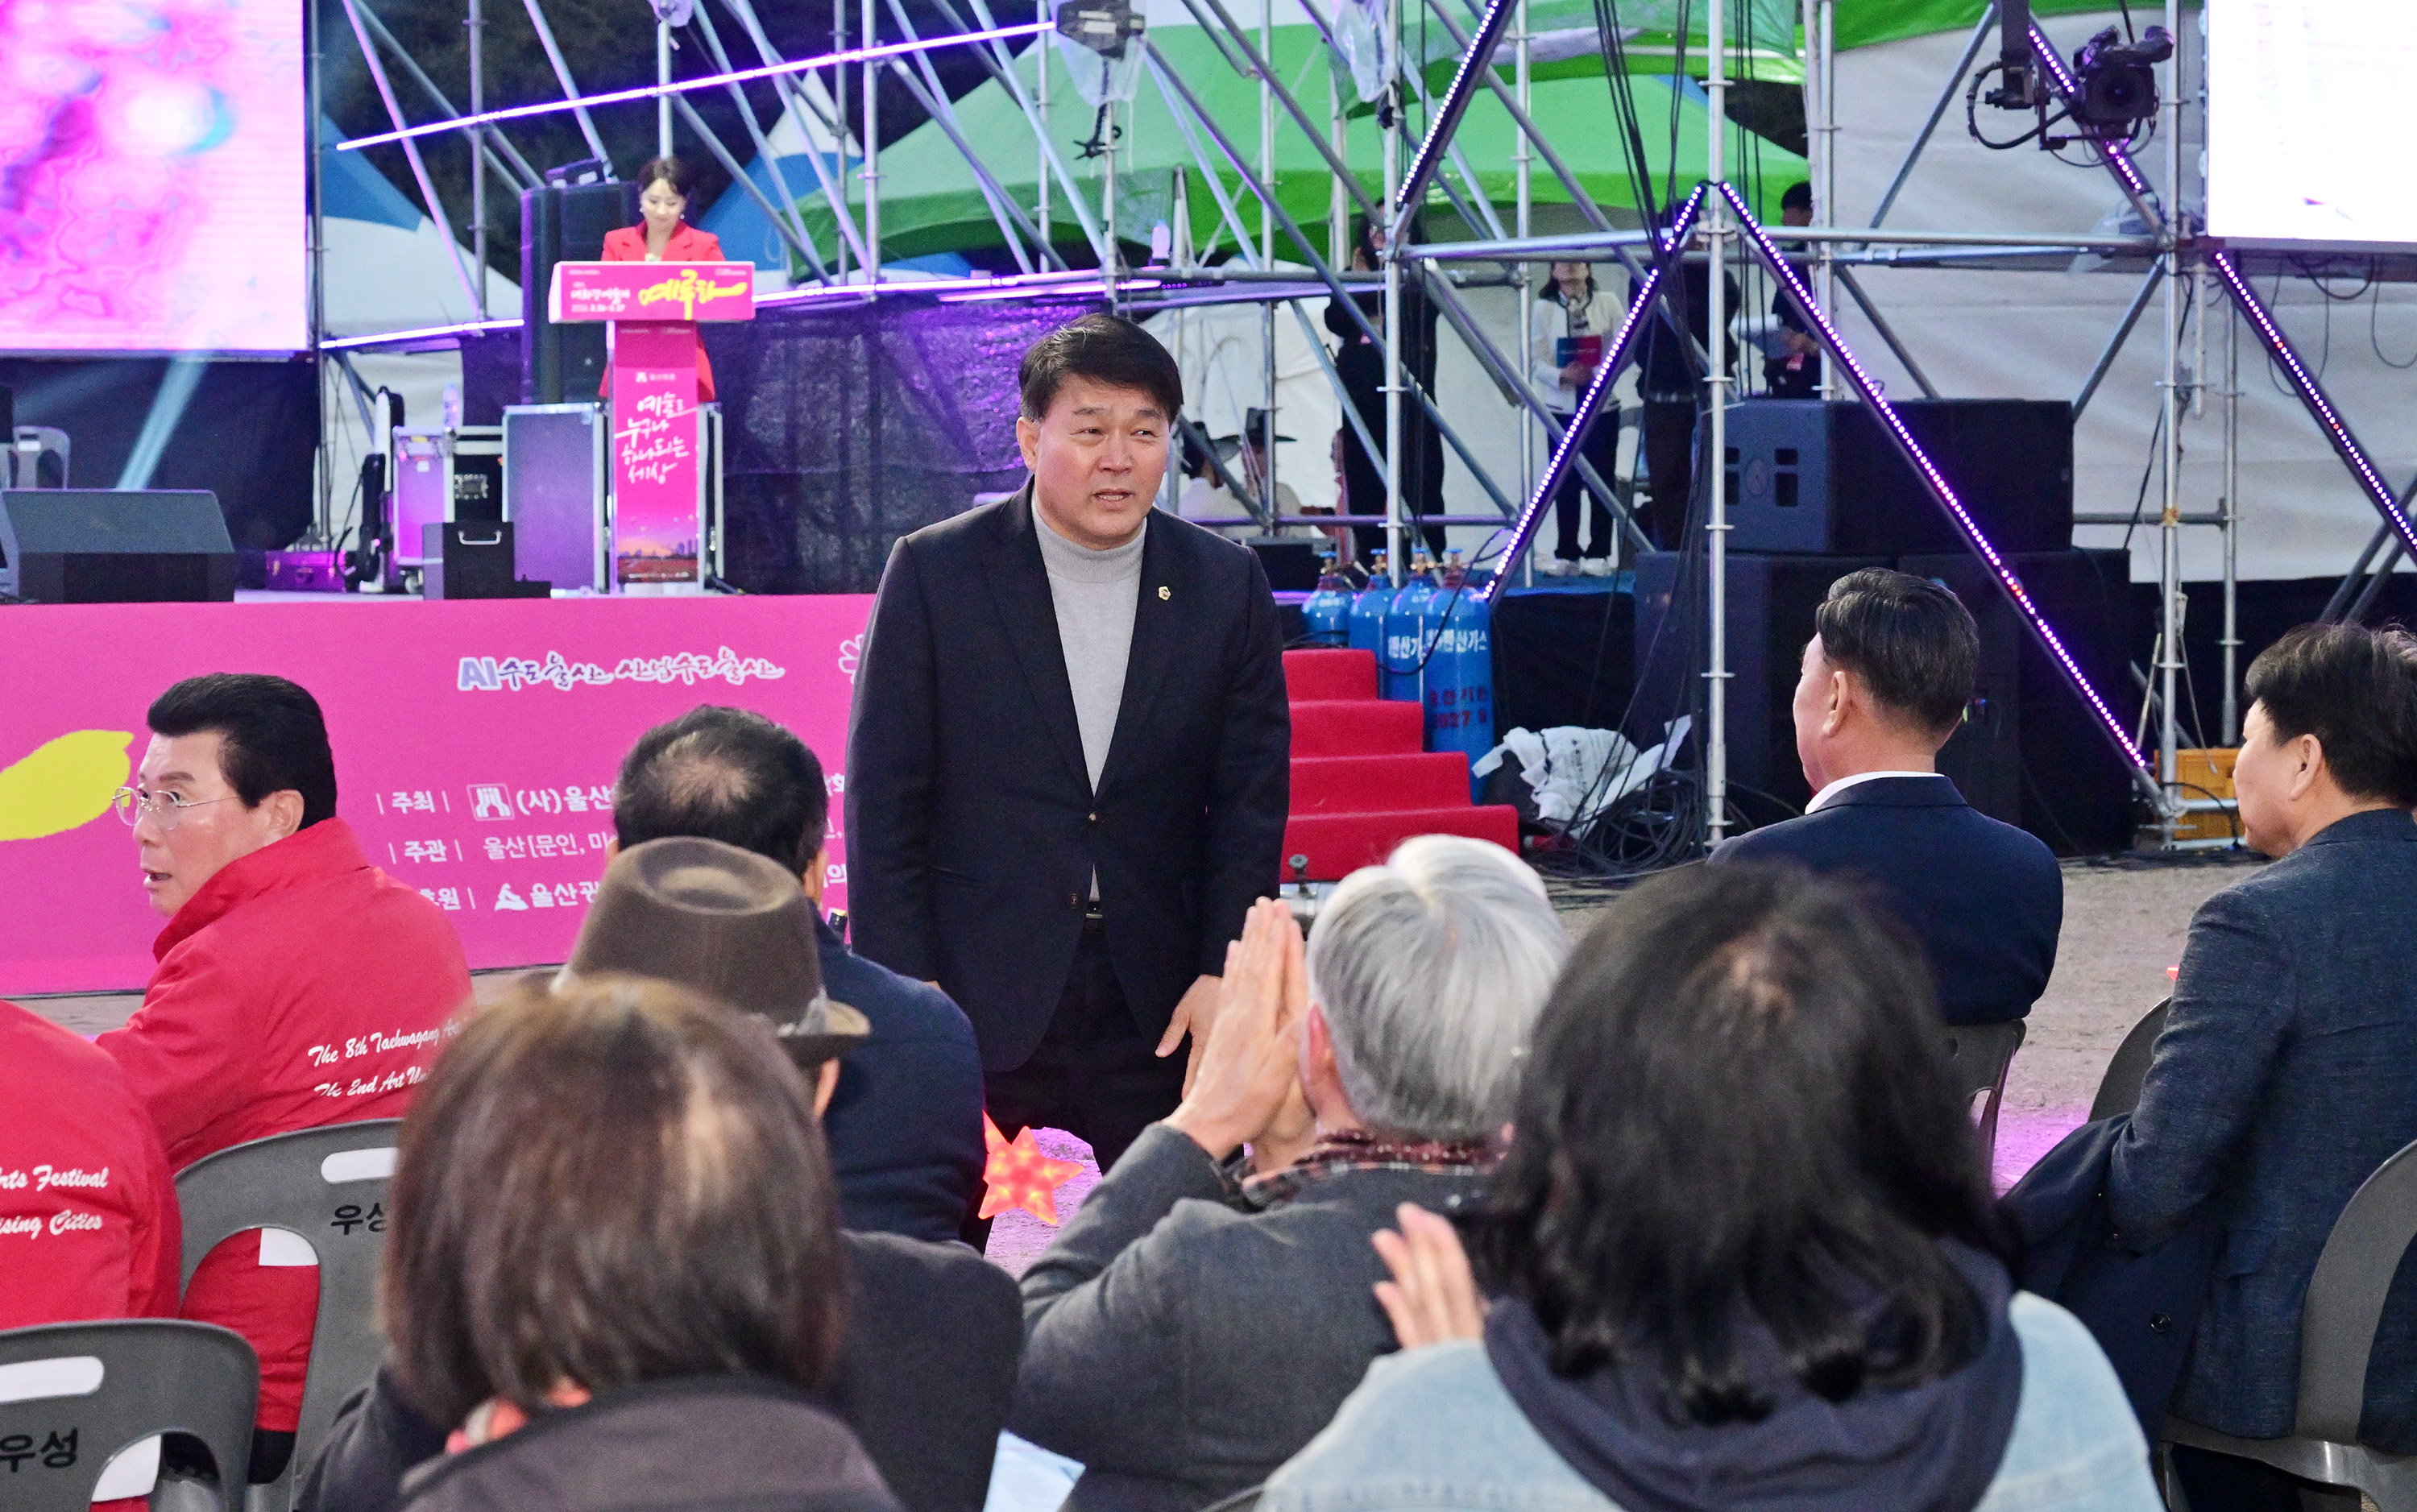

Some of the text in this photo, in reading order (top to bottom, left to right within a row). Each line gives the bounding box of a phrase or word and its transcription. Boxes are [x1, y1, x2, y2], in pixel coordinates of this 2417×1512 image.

[614, 417, 670, 449] 누구나
[628, 461, 678, 484] 세상
[392, 790, 435, 814] 주최
[404, 839, 447, 863] 주관
[308, 1044, 338, 1067] The
[345, 1036, 368, 1058] 8th
[346, 1075, 379, 1096] 2nd
[379, 1071, 404, 1092] Art
[33, 1165, 109, 1191] Festival
[49, 1209, 102, 1236] Cities
[0, 1427, 78, 1473] 우성
